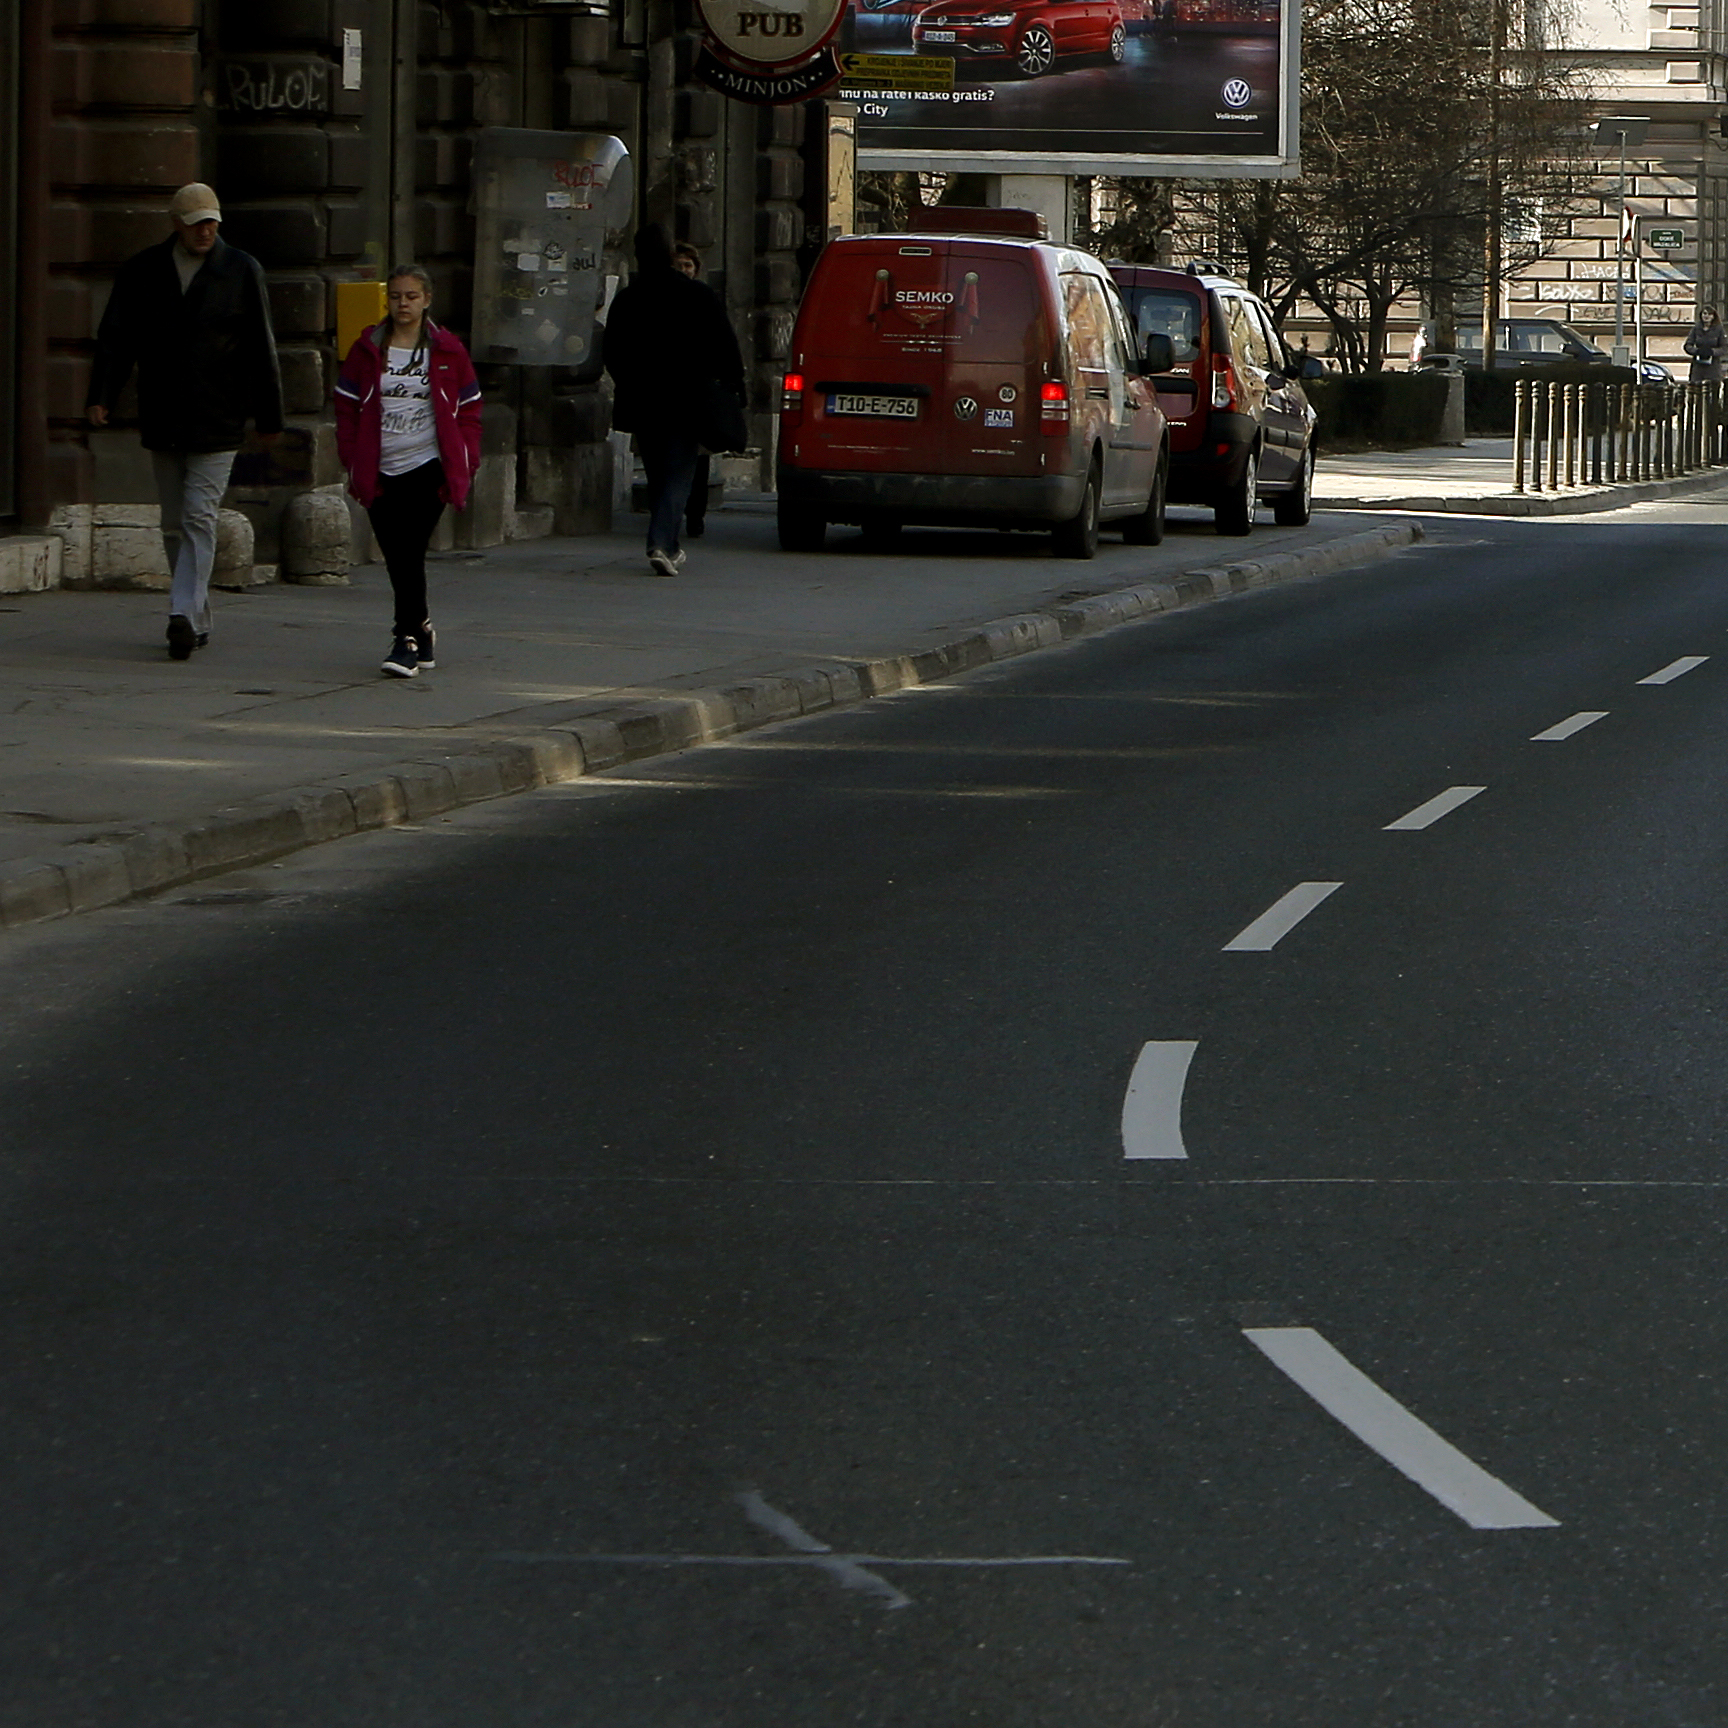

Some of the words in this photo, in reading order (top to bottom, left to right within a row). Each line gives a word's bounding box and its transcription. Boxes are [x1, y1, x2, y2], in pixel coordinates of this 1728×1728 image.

[737, 12, 804, 38] PUB
[724, 73, 809, 98] MINJON
[952, 89, 995, 103] gratis?
[863, 103, 889, 117] City
[895, 290, 954, 304] SEMKO
[837, 396, 916, 415] T10-E-756
[986, 410, 1012, 421] FNA
